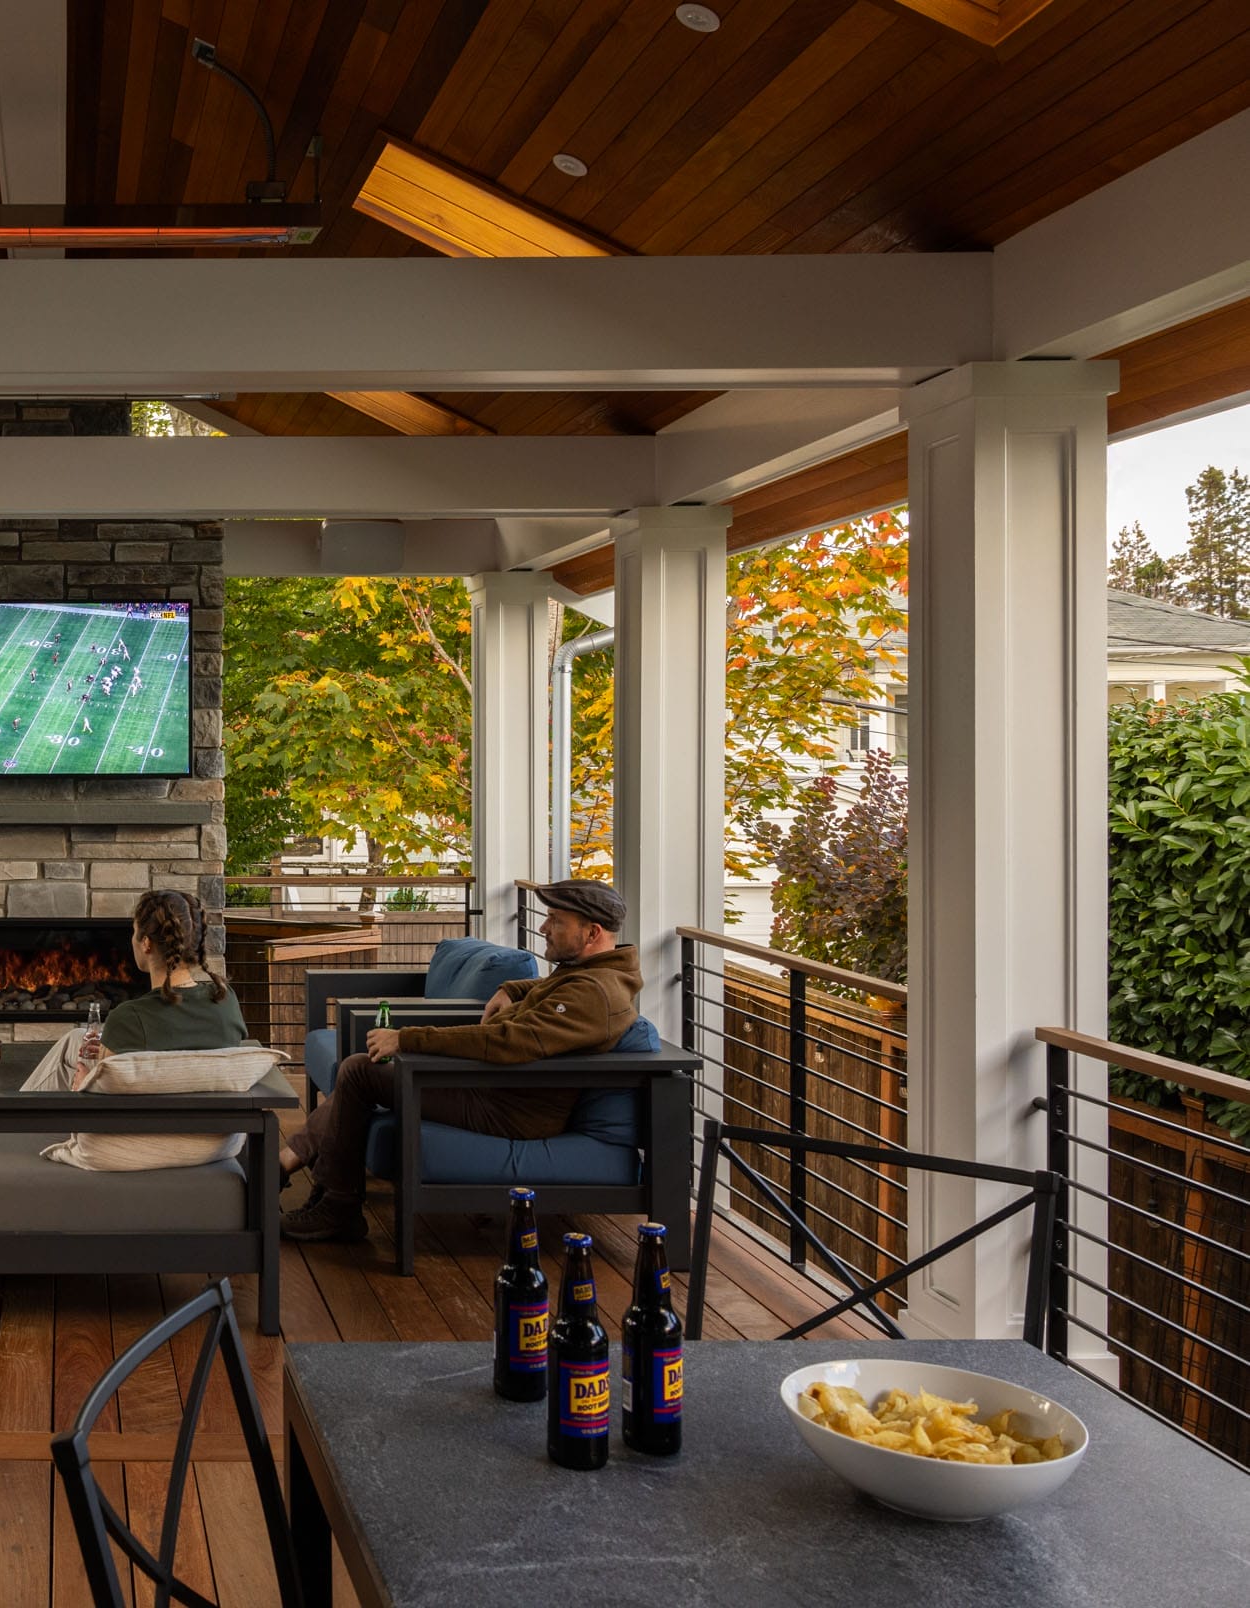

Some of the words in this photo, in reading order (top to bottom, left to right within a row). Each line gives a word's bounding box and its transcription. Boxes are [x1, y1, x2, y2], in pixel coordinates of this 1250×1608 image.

[50, 734, 80, 747] 30
[132, 745, 164, 758] 40
[577, 1402, 597, 1412] ROOT
